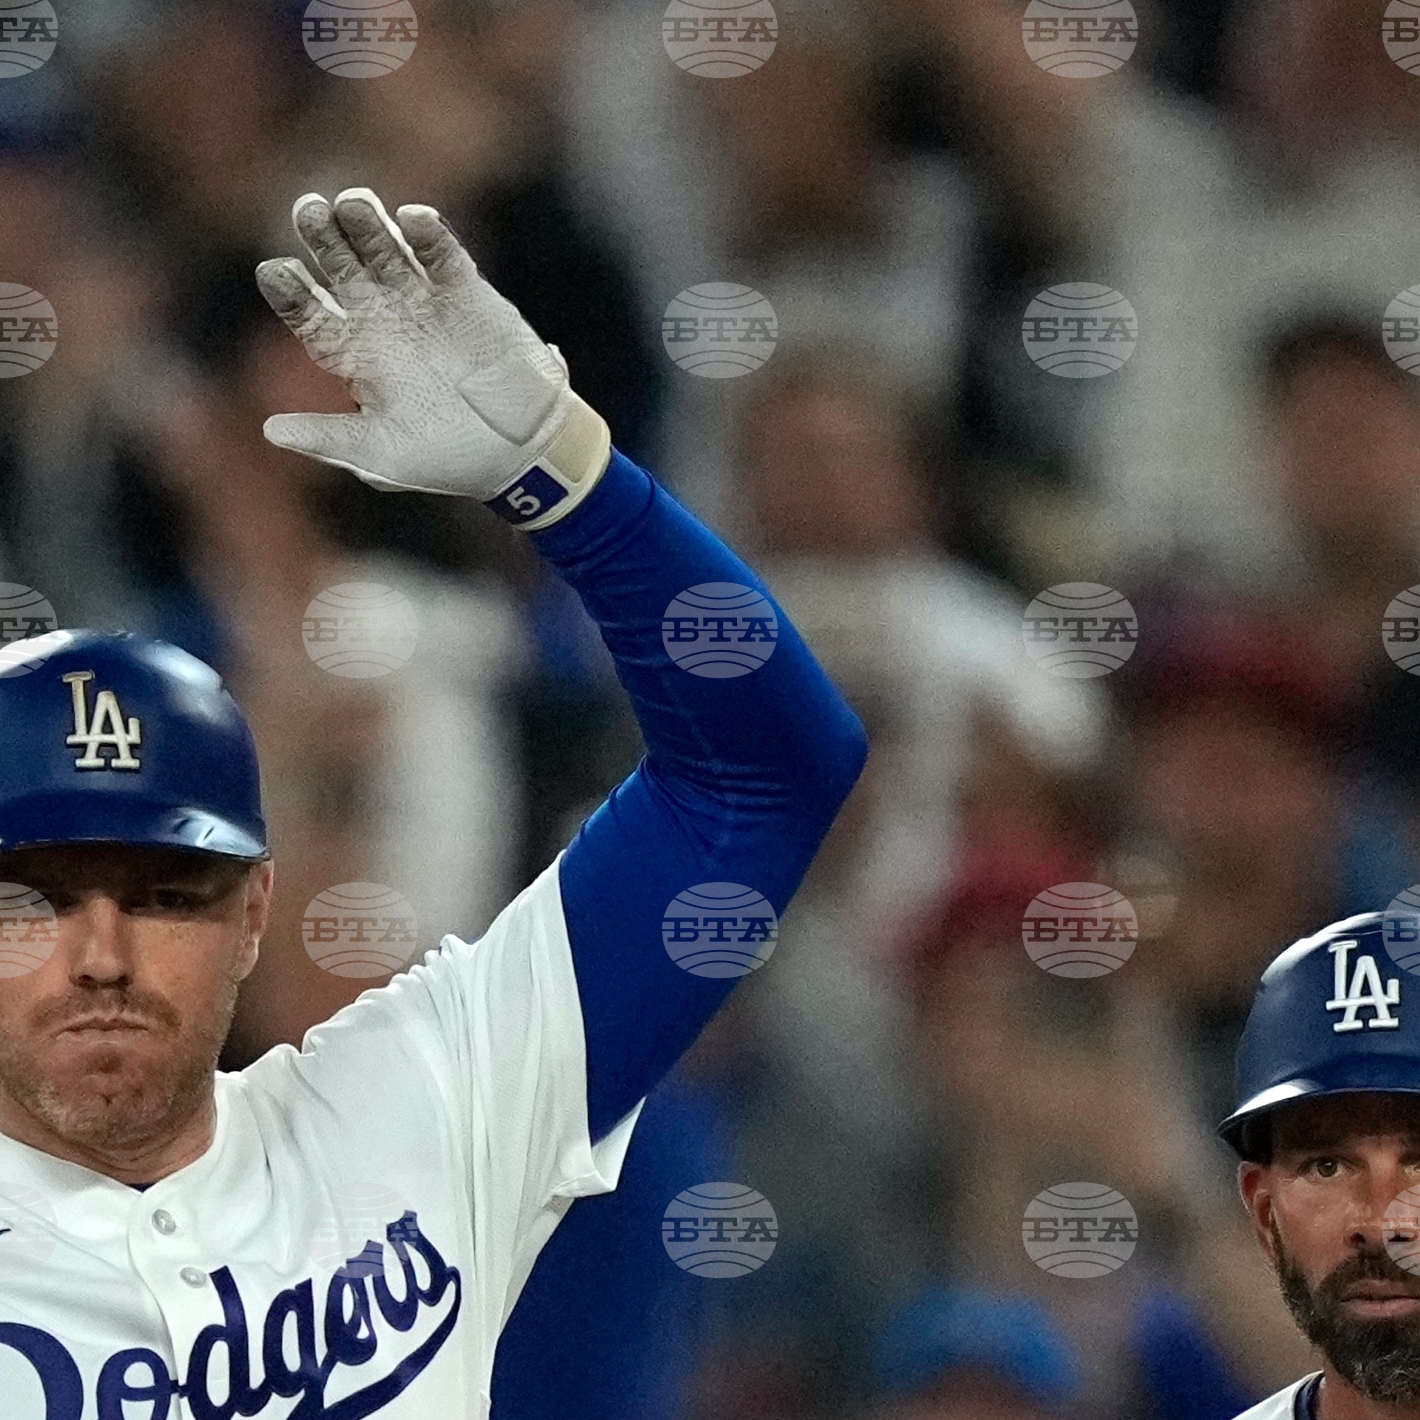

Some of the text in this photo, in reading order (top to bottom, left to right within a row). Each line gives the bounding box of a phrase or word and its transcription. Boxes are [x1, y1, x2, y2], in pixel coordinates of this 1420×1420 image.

[505, 485, 542, 516] 5
[62, 670, 143, 770] LA
[1325, 939, 1401, 1033] LA
